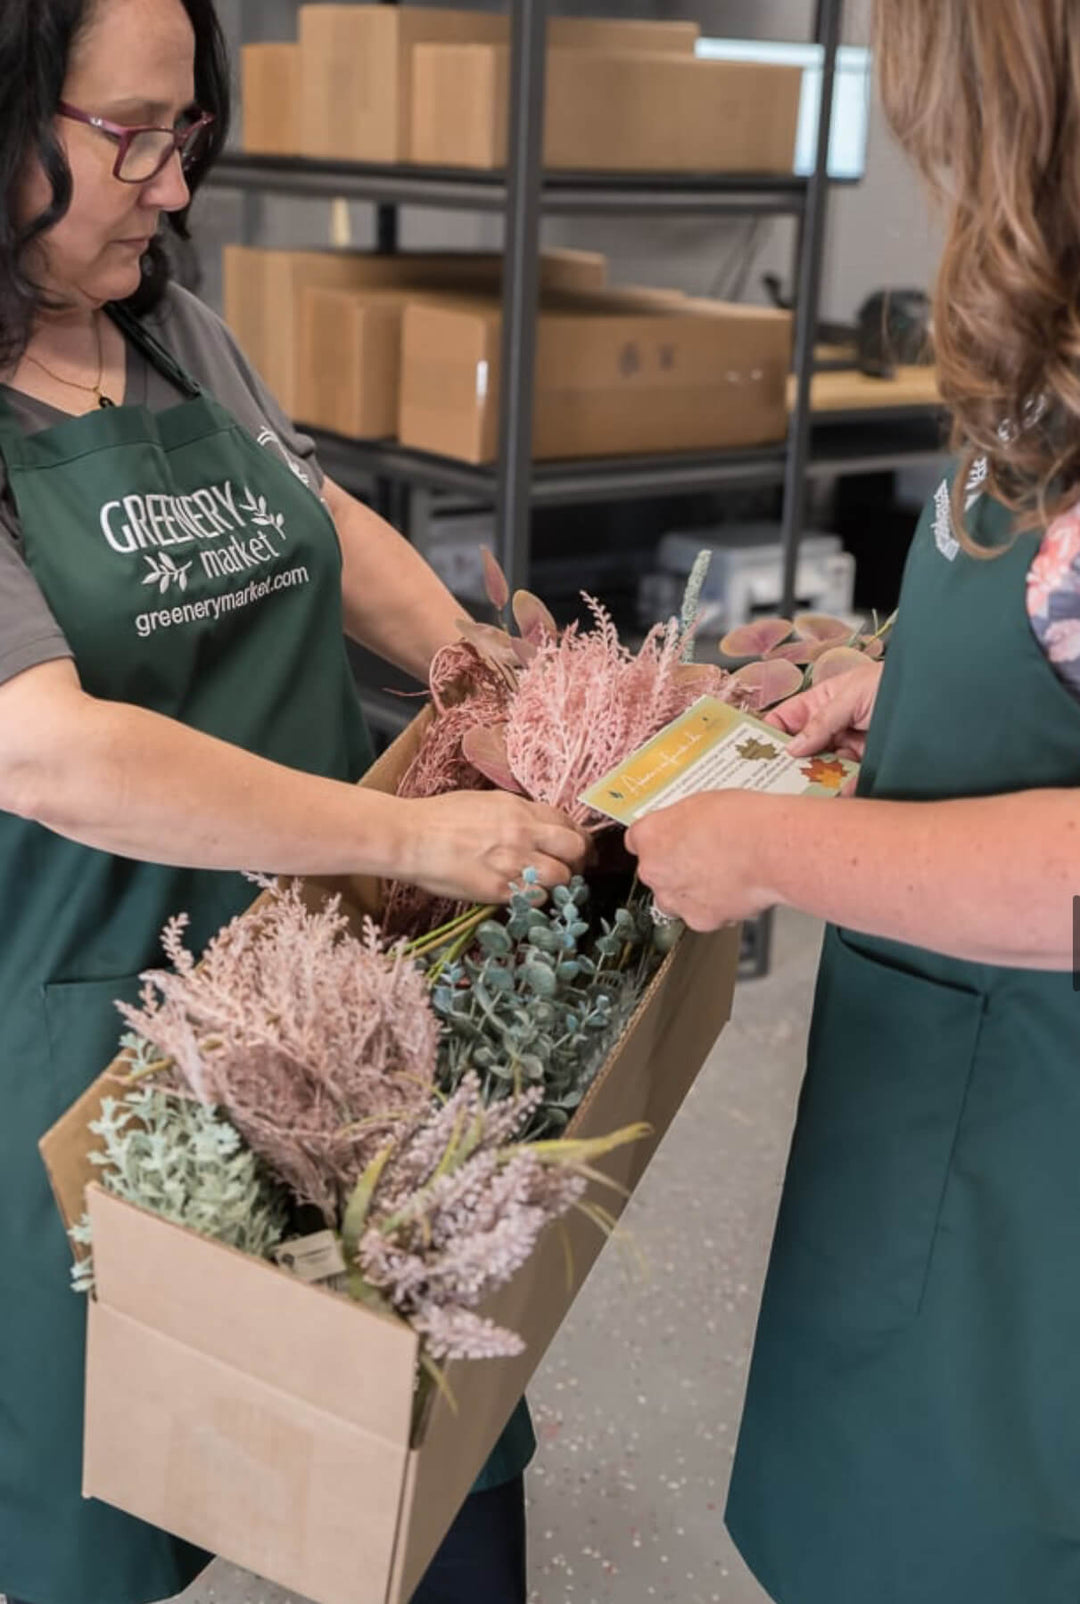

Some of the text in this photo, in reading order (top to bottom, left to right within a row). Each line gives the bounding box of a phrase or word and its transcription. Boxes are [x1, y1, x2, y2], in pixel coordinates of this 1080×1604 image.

[100, 480, 246, 553] GREENERY
[200, 530, 280, 579] market
[135, 566, 309, 637] greenerymarket.com
